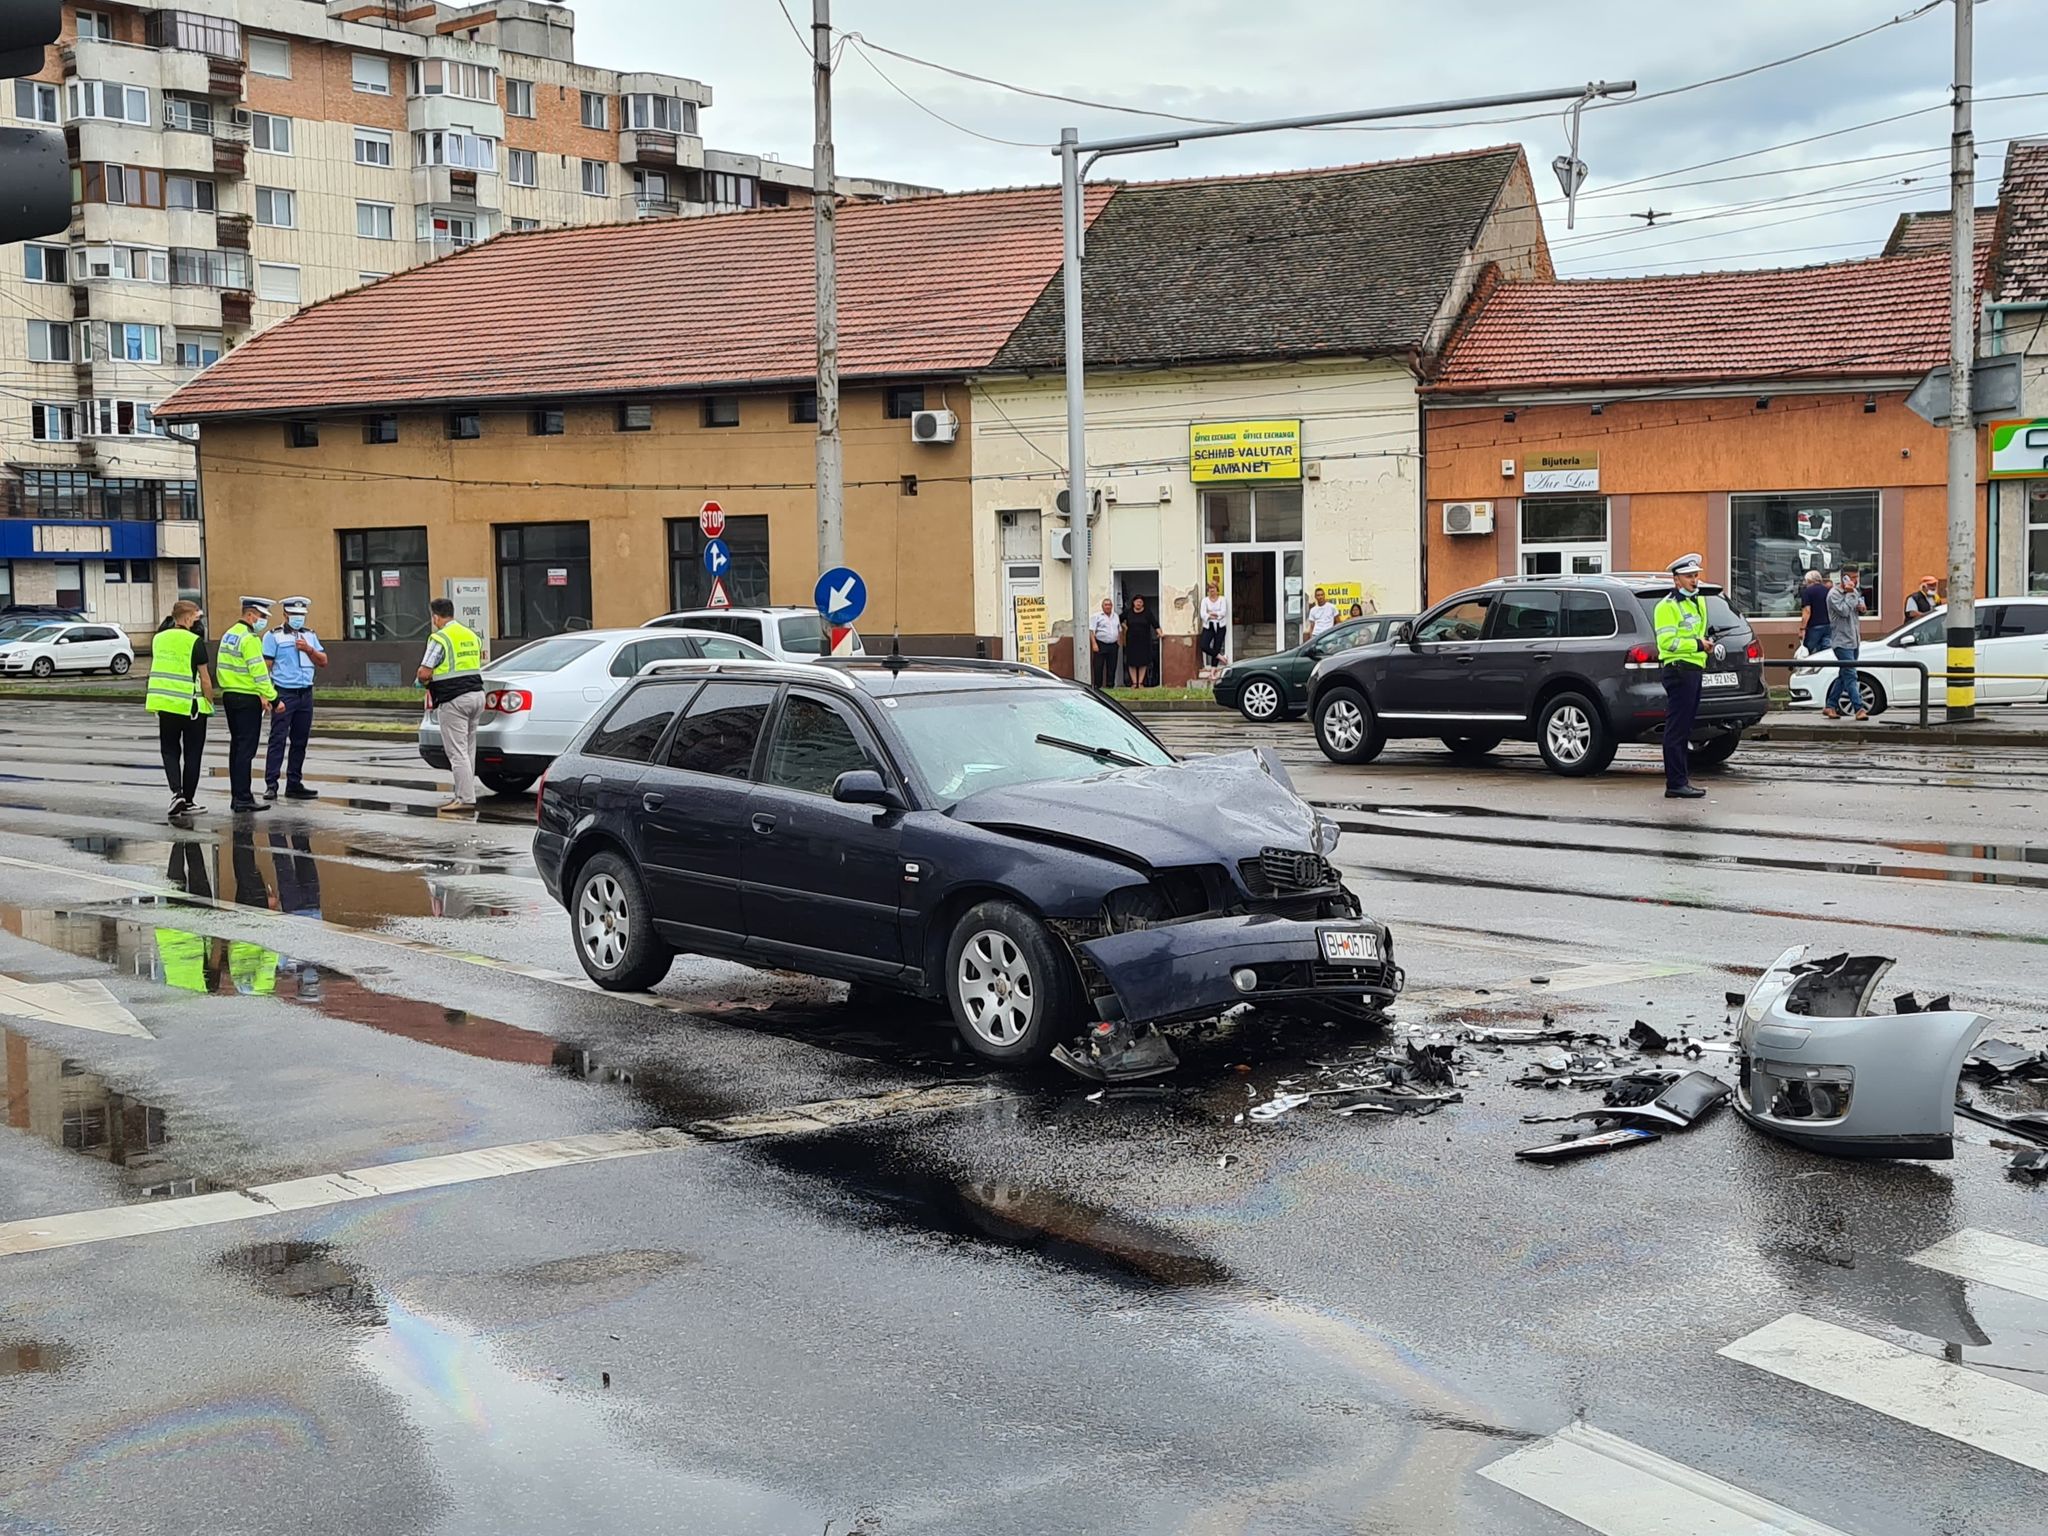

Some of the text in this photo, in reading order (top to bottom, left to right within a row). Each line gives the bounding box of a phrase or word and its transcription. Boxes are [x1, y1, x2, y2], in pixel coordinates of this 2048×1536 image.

[1195, 433, 1237, 442] OFFICE EXCHANGE
[1243, 431, 1295, 440] OFFICE EXCHANGE
[1194, 445, 1293, 460] SCHIMB VALUTAR
[1541, 457, 1580, 467] Bijuteria
[1213, 462, 1271, 475] AMANET
[1563, 472, 1594, 488] Lux
[702, 510, 723, 529] STOP
[1017, 597, 1045, 606] EXCHANGE
[462, 606, 481, 616] POMPE
[468, 619, 475, 628] DE
[1327, 933, 1346, 956] BH
